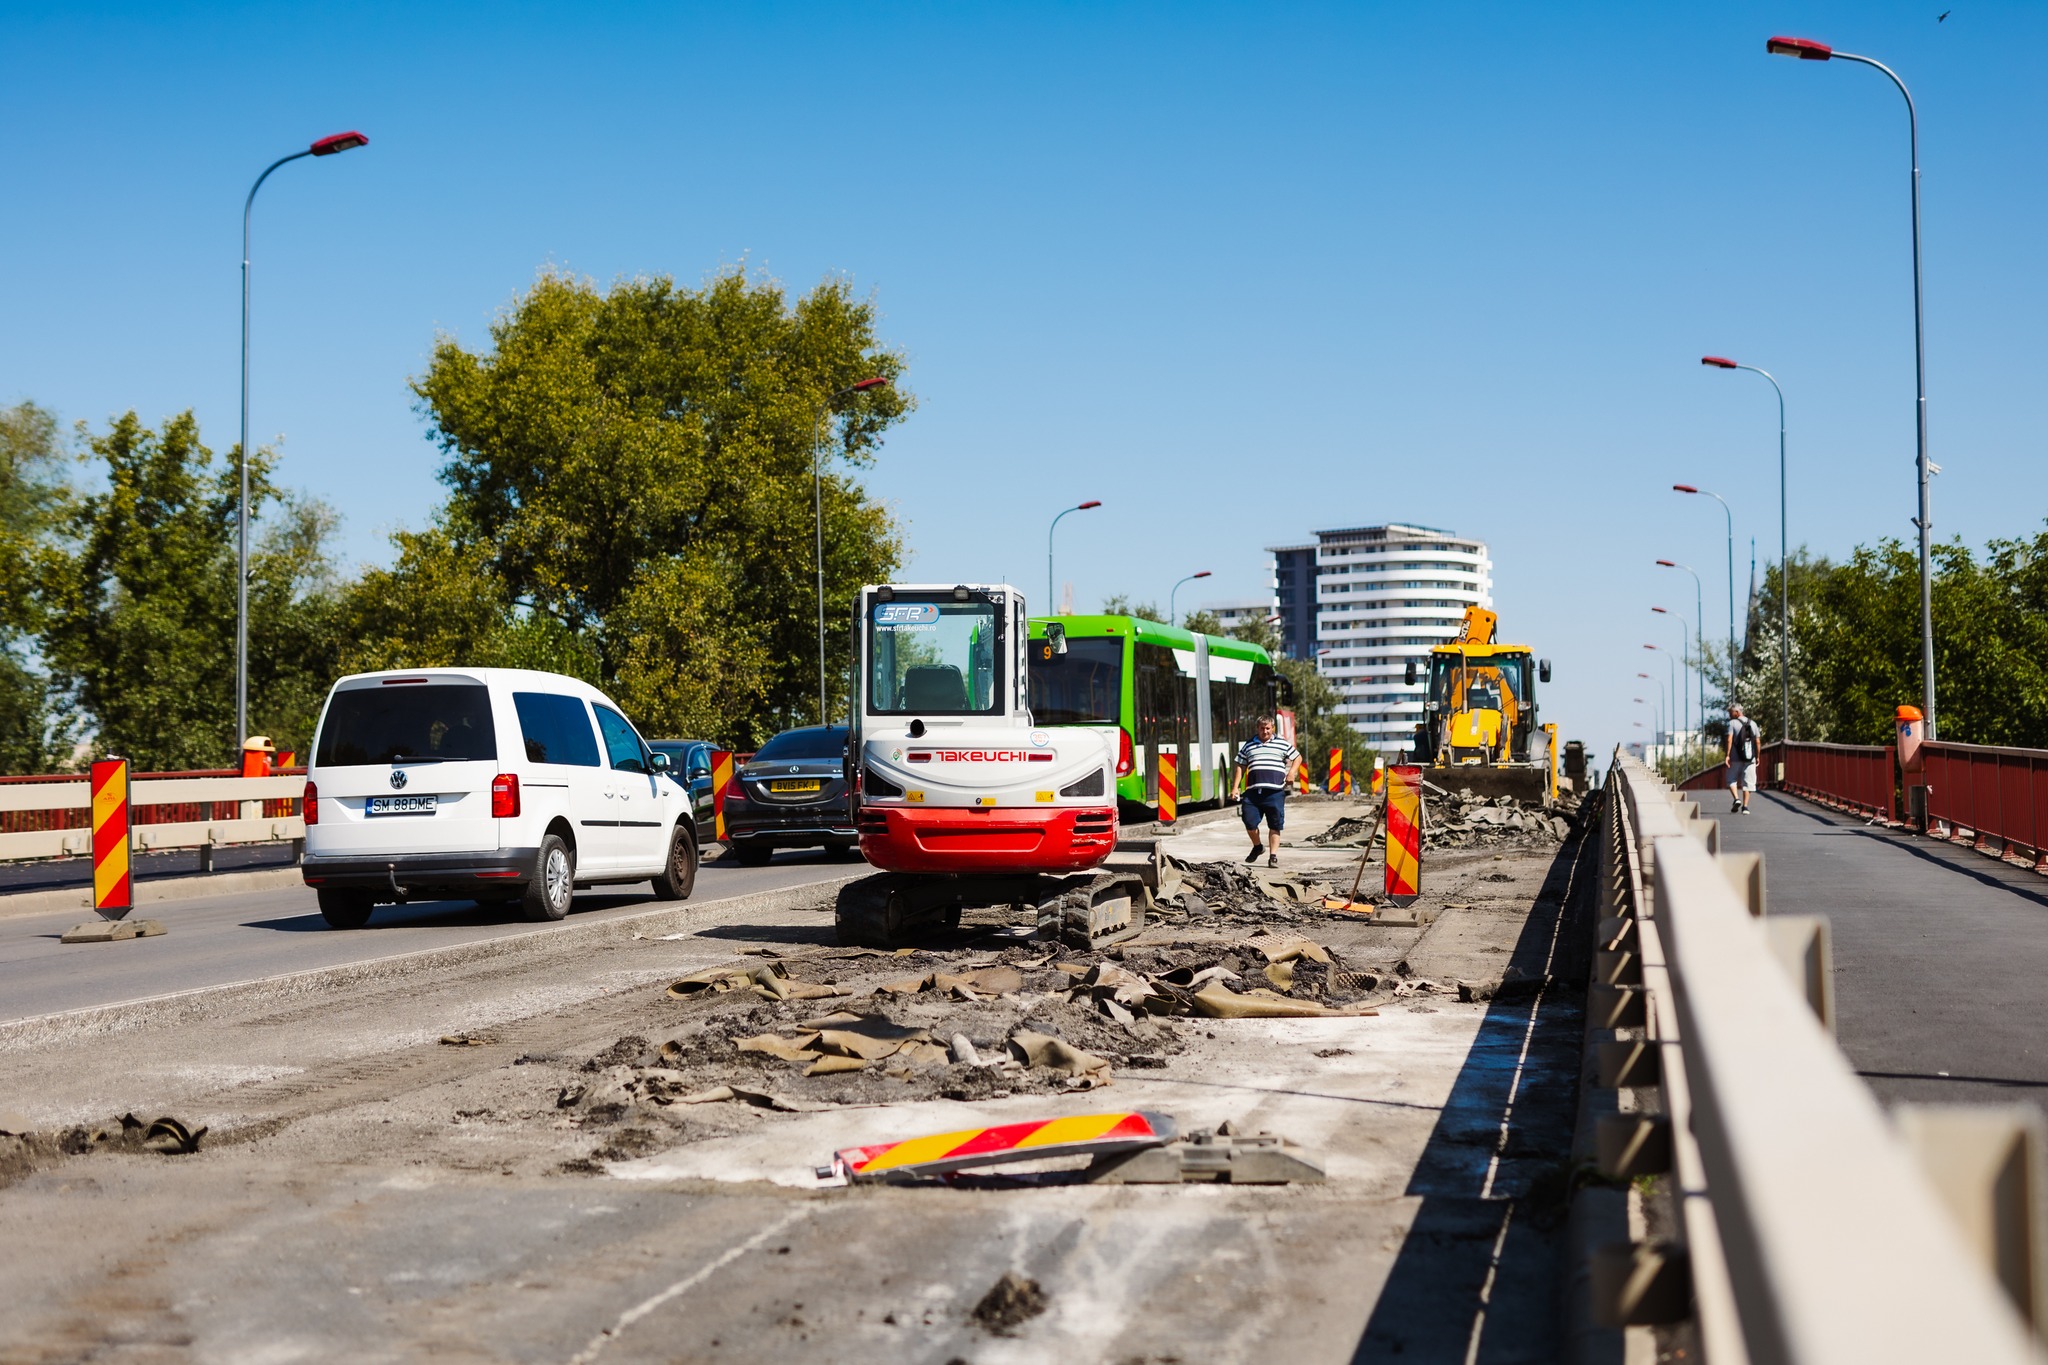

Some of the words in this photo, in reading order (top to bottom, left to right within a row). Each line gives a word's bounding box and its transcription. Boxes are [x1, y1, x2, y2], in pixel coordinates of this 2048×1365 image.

[879, 607, 922, 621] SFR
[1043, 645, 1052, 660] 9
[935, 751, 1027, 762] TAKEUCHI
[776, 782, 796, 790] BV15
[373, 799, 390, 812] SM
